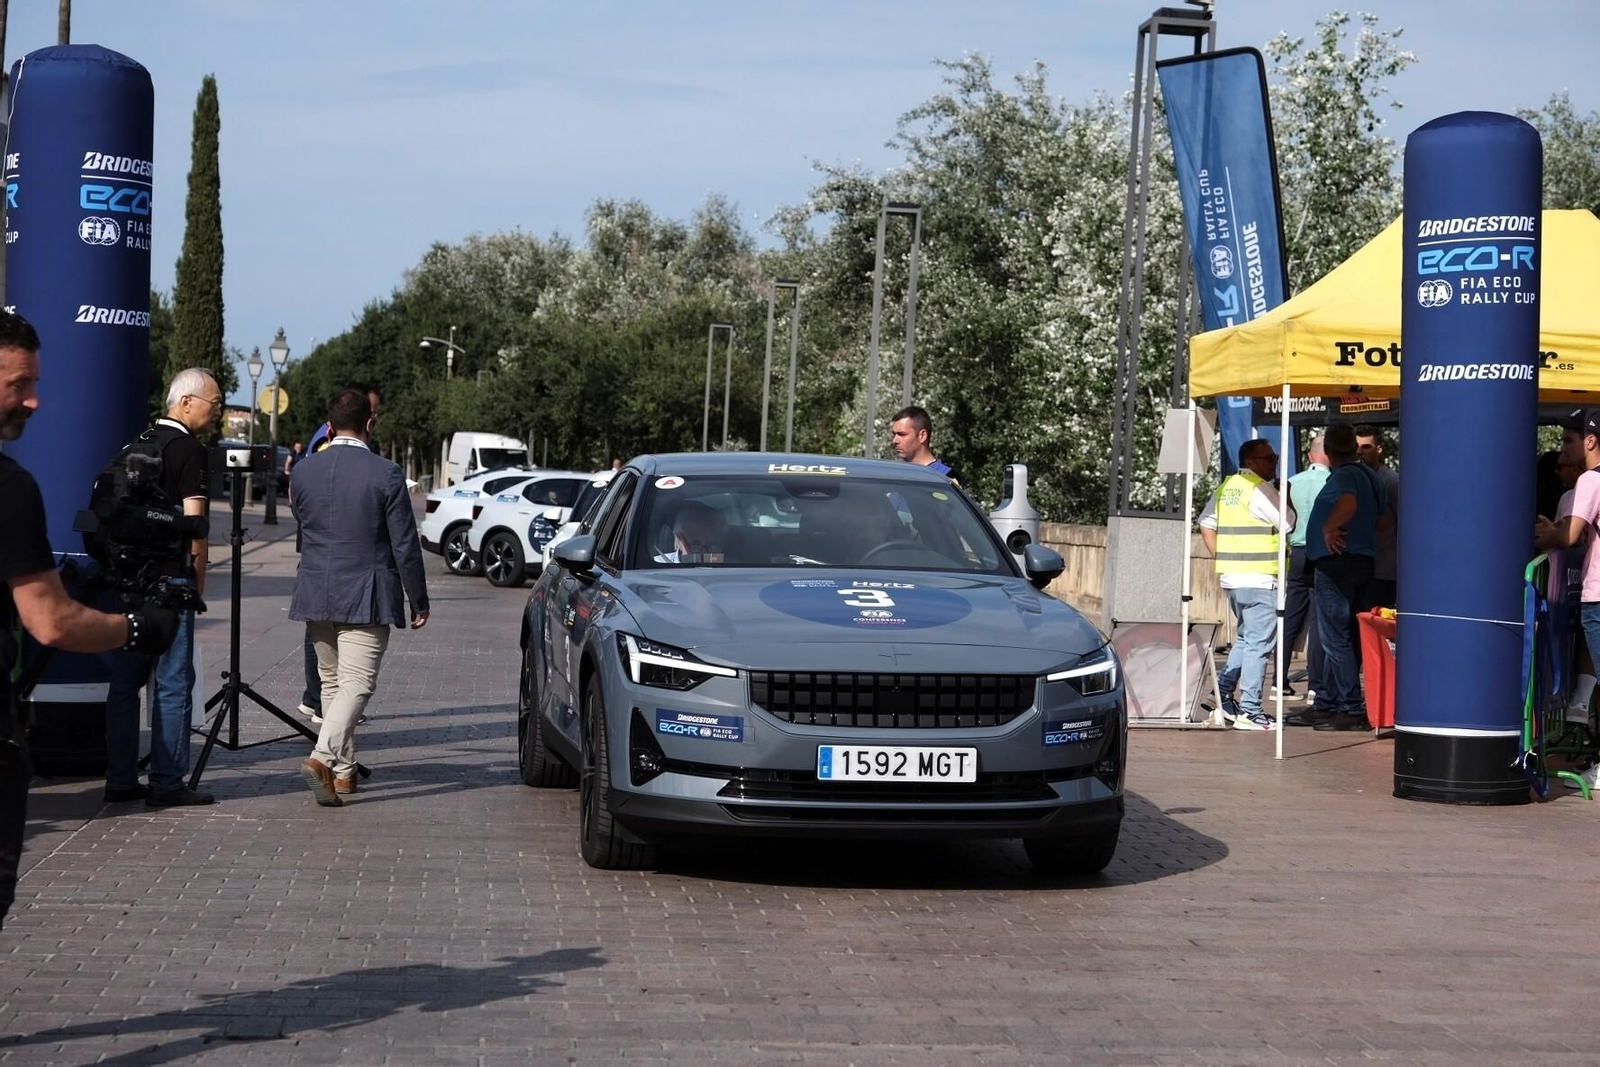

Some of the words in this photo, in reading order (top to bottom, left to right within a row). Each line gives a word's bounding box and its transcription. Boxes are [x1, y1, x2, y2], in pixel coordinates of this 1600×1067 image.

[127, 220, 144, 233] FIA
[1418, 216, 1535, 238] BRIDGESTONE
[1461, 277, 1487, 289] FIA
[1493, 276, 1521, 288] ECO
[1461, 292, 1509, 304] RALLY
[1515, 292, 1535, 304] CUP
[1418, 364, 1534, 382] BRIDGESTONE
[768, 463, 847, 473] Hertz
[147, 510, 174, 522] RONIN
[852, 581, 915, 589] Hertz
[837, 588, 896, 607] 3
[677, 713, 719, 725] BRIDGESTONE
[842, 751, 908, 776] 1592
[919, 752, 969, 777] MGT
